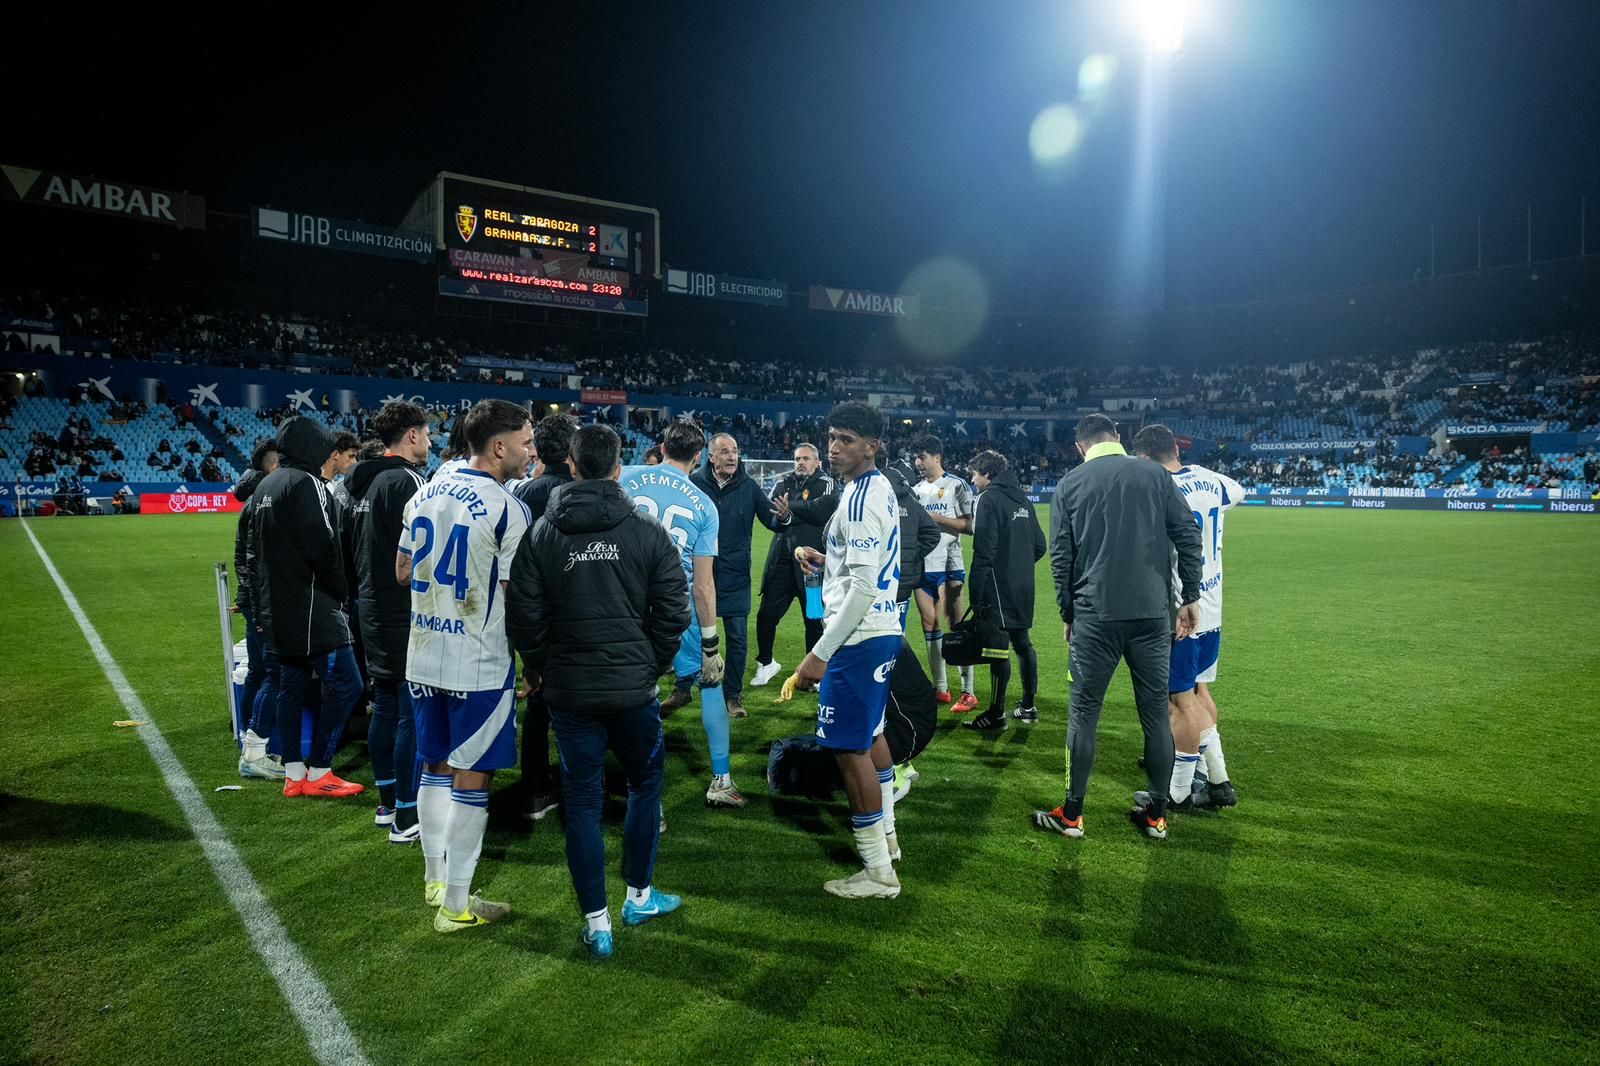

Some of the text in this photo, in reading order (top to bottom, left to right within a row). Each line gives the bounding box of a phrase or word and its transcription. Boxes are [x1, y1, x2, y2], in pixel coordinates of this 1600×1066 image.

[43, 175, 176, 221] AMBAR
[484, 208, 514, 223] REAL
[588, 226, 596, 236] 2
[291, 214, 432, 254] JAB CLIMATIZACIÓN
[588, 242, 596, 252] 2
[454, 250, 515, 266] CARAVAN
[462, 269, 588, 291] www.realzaragoza.com
[577, 267, 618, 283] AMBAR
[688, 272, 783, 299] JAB ELECTRICIDAD
[503, 287, 553, 303] impossible
[561, 295, 595, 308] nothing
[845, 292, 905, 314] AMBAR
[1447, 425, 1498, 435] SKODA
[1285, 442, 1319, 450] MONCAYO
[629, 473, 704, 512] J.FEMENÍAS
[1194, 480, 1219, 497] MOYA
[1348, 487, 1380, 497] PARKING
[187, 495, 227, 507] COPA REY
[414, 481, 488, 520] LLUÍS LÓPEZ
[1271, 498, 1301, 506] hiberus
[1352, 498, 1385, 508] hiberus
[1447, 500, 1486, 510] hiberus
[1550, 501, 1594, 511] hiberus
[585, 540, 620, 553] REAL
[411, 516, 470, 602] 24
[564, 551, 620, 571] ZARAGOZA
[415, 613, 466, 635] AMBAR
